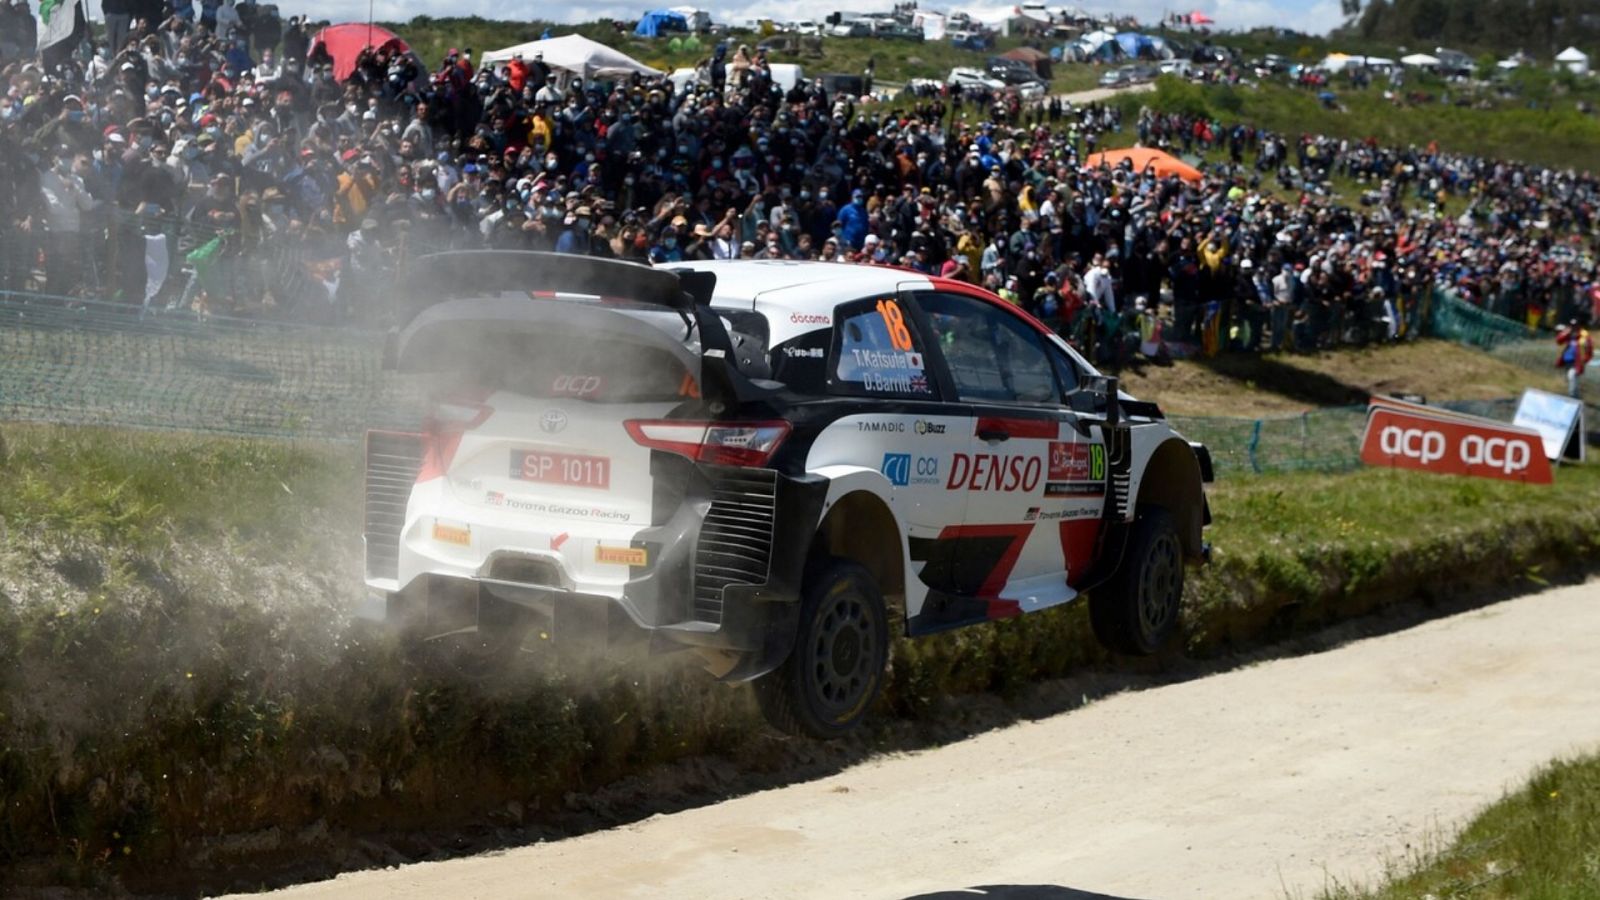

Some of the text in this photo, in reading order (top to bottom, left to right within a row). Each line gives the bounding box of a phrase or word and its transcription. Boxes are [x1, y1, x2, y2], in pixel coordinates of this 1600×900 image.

[790, 312, 830, 325] docomo
[875, 299, 912, 353] 18
[852, 349, 906, 369] T.Katsuta
[552, 375, 600, 396] acp
[863, 372, 912, 393] D.Barritt
[857, 421, 905, 432] TAMADIC
[1380, 425, 1531, 474] acp acp
[525, 454, 604, 485] SP 1011
[916, 457, 939, 475] CCI
[946, 453, 1042, 492] DENSO
[1090, 445, 1104, 481] 18
[591, 508, 631, 521] Racing
